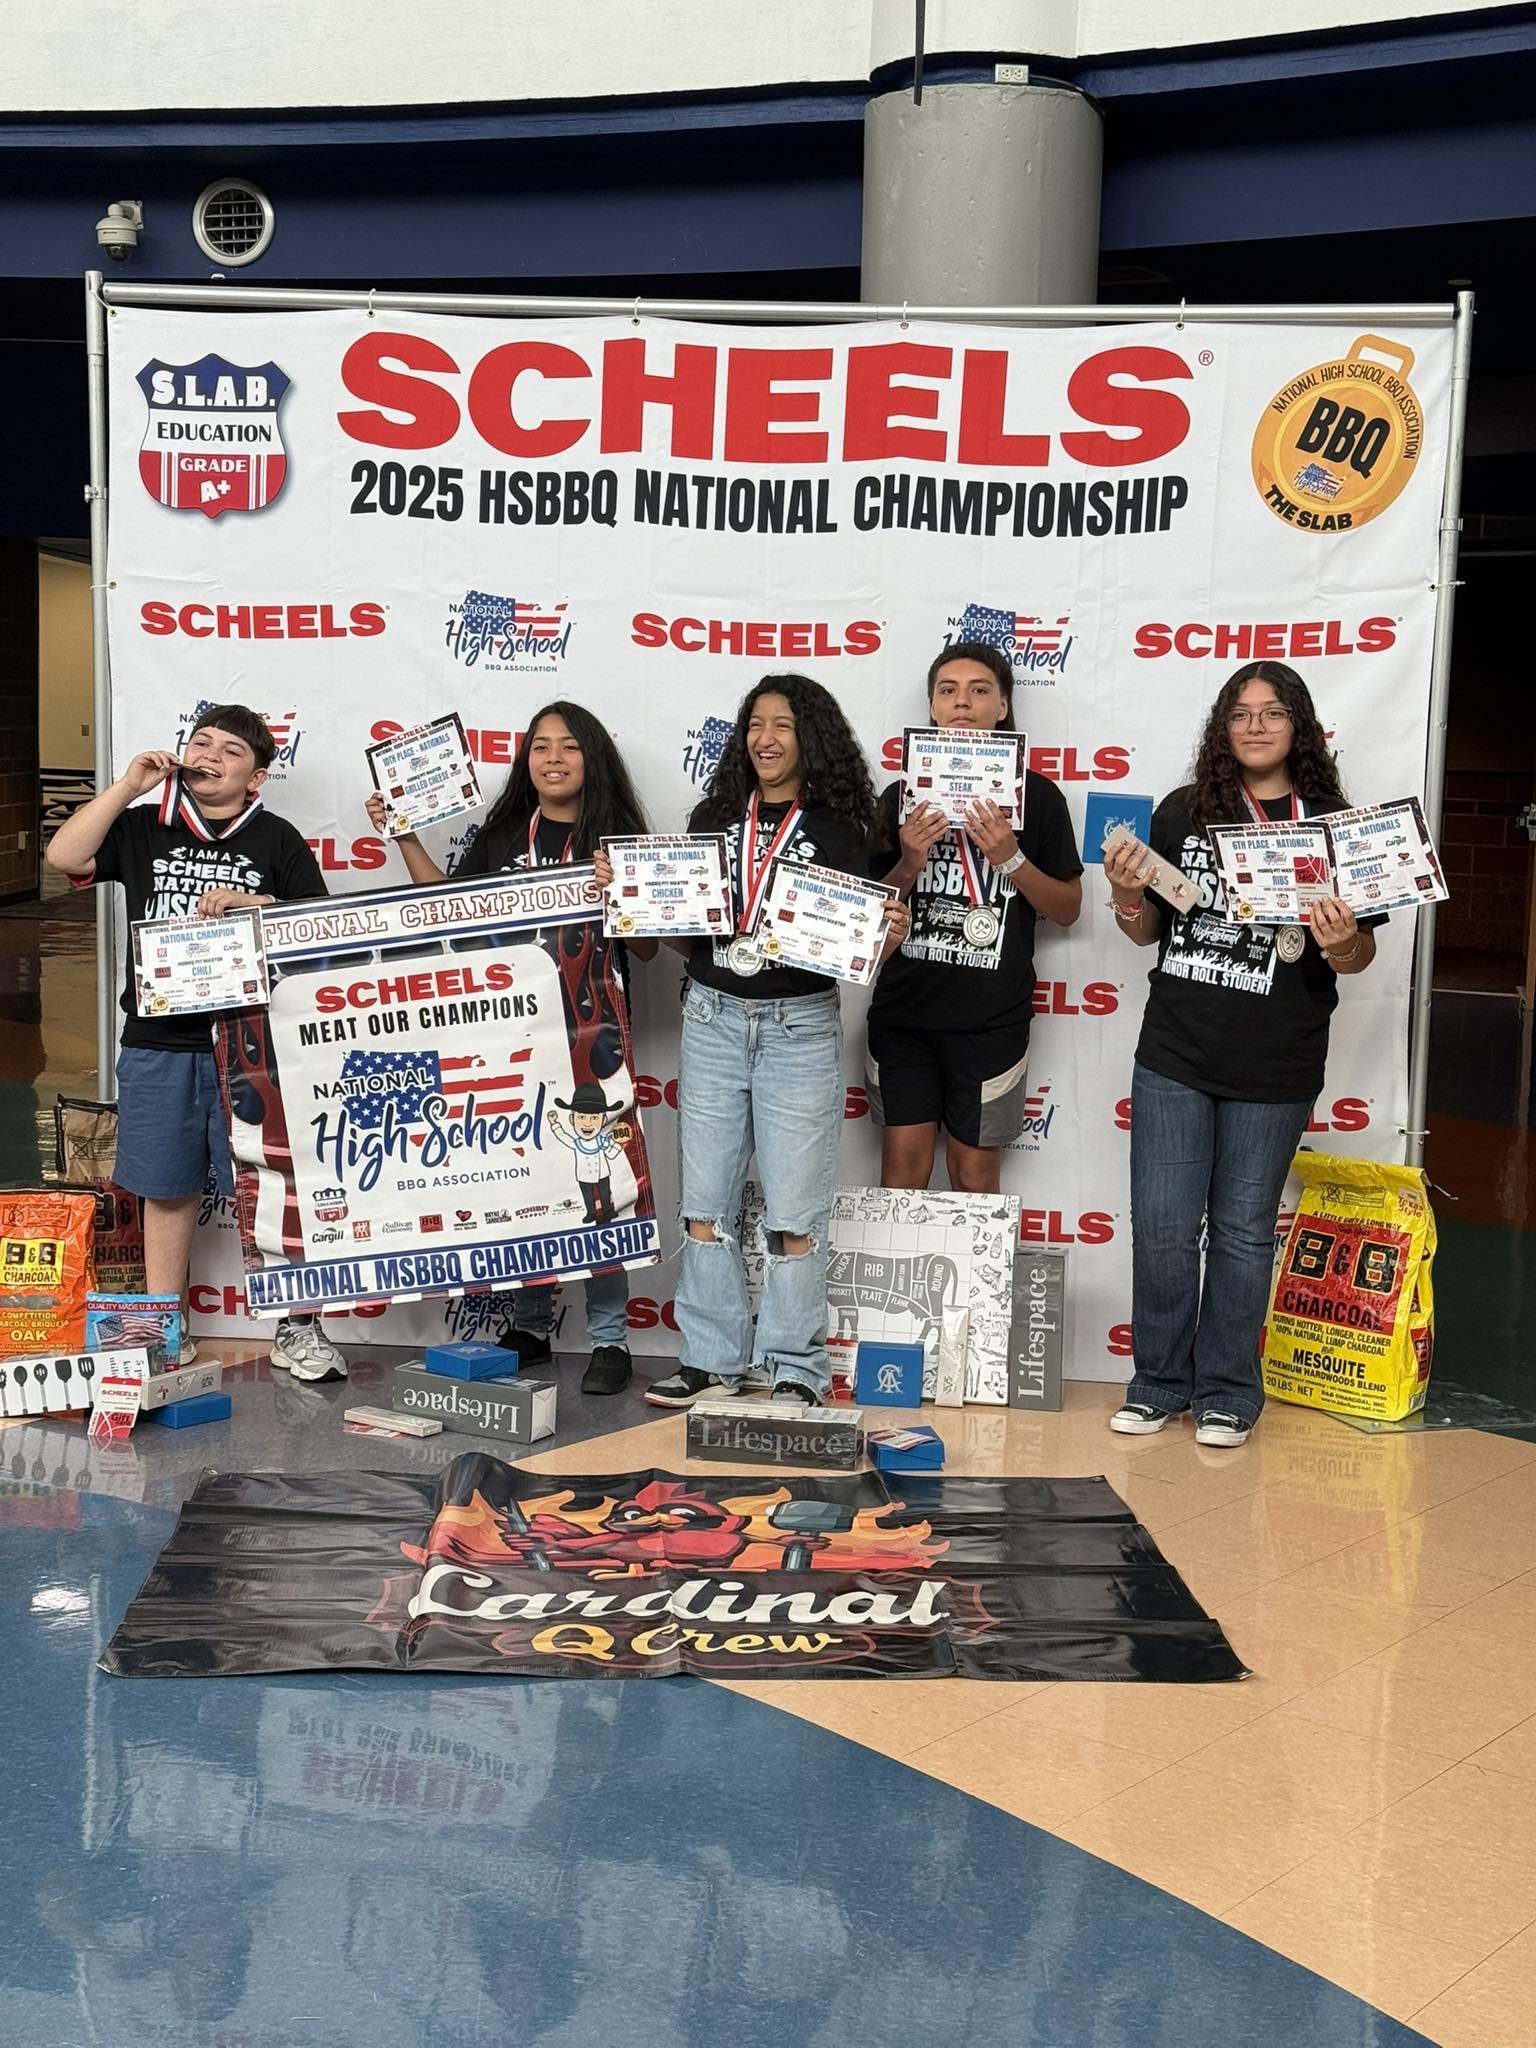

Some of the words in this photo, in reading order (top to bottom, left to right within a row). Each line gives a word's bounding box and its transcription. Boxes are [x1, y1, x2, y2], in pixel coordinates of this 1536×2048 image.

[151, 370, 275, 406] S.L.A.B.
[337, 332, 1194, 467] SCHEELS
[1272, 372, 1319, 413] NATIONAL
[1320, 364, 1345, 382] HIGH
[1347, 364, 1385, 385] SCHOOL
[1383, 375, 1404, 399] BBQ
[1397, 393, 1421, 459] ASSOCIATION
[157, 421, 272, 442] EDUCATION
[1295, 396, 1391, 480] BBQ
[179, 457, 248, 473] GRADE
[200, 479, 231, 503] A+
[350, 459, 463, 523] 2025
[478, 469, 618, 529] HSBBQ
[633, 469, 838, 535] NATIONAL
[852, 474, 1188, 537] CHAMPIONSHIP
[1264, 484, 1299, 521] THE
[1296, 513, 1353, 531] SLAB
[140, 601, 386, 640] SCHEELS
[449, 603, 511, 616] NATIONAL
[631, 611, 882, 658] SCHEELS
[947, 617, 1011, 630] NATIONAL
[445, 619, 493, 667] High
[499, 621, 572, 660] School
[1133, 616, 1396, 659] SCHEELS
[504, 664, 558, 673] ASSOCIATION
[391, 723, 432, 743] SCHEELS
[939, 729, 990, 738] SCHEELS
[396, 747, 416, 761] PLACE
[419, 733, 451, 750] NATIONALS
[916, 743, 943, 754] RESERVE
[944, 745, 974, 756] NATIONAL
[975, 747, 1010, 758] CHAMPION
[428, 770, 450, 786] CHEESE
[949, 781, 973, 793] STEAK
[1325, 804, 1379, 823] SCHEELS
[1242, 822, 1297, 831] SCHEELS
[1333, 828, 1353, 842] LACE
[1358, 818, 1402, 837] NATIONALS
[637, 835, 690, 843] SCHEELS
[1232, 840, 1247, 850] 6TH
[1248, 839, 1270, 849] PLACE
[1276, 838, 1315, 849] NATIONALS
[196, 849, 219, 861] AM
[221, 852, 231, 862] A
[623, 852, 638, 862] 4TH
[639, 852, 661, 862] PLACE
[668, 851, 706, 861] NATIONALS
[152, 858, 262, 887] SCHEELS
[808, 865, 862, 885] SCHEELS
[1272, 875, 1290, 886] RIBS
[1350, 863, 1385, 880] BRISKET
[652, 888, 684, 898] CHICKEN
[792, 878, 827, 896] NATIONAL
[828, 888, 867, 907] CHAMPION
[263, 908, 389, 947] TIONAL
[400, 879, 602, 928] CHAMPIONS
[160, 933, 194, 944] NATIONAL
[196, 928, 236, 940] CHAMPION
[192, 965, 212, 976] CHILI
[928, 949, 954, 965] ROLL
[955, 952, 1002, 971] STUDENT
[315, 962, 514, 1014] SCHEELS
[1191, 966, 1219, 985] ROLL
[1221, 971, 1274, 996] STUDENT
[298, 1016, 357, 1046] MEAT
[368, 1010, 410, 1038] OUR
[418, 993, 539, 1029] CHAMPIONS
[312, 1069, 434, 1101] NATIONAL
[310, 1102, 408, 1192] High
[421, 1082, 546, 1168] School
[613, 1127, 631, 1139] BBQ
[397, 1178, 428, 1191] BBQ
[432, 1166, 531, 1188] ASSOCIATION
[1366, 1219, 1386, 1228] LONG
[312, 1229, 344, 1243] Cargill
[248, 1262, 369, 1305] NATIONAL
[375, 1252, 464, 1291] MSBBQ
[470, 1221, 655, 1280] CHAMPIONSHIP
[831, 1254, 852, 1280] CHUCK
[864, 1263, 884, 1278] RIB
[4, 1271, 57, 1283] CHARCOAL
[931, 1263, 945, 1293] ROUND
[87, 1302, 117, 1311] QUALITY
[118, 1302, 139, 1310] MADE
[860, 1289, 883, 1303] PLATE
[891, 1296, 909, 1308] FLANK
[1, 1312, 57, 1320] COMPETITION
[445, 1299, 494, 1342] High
[1283, 1291, 1384, 1331] CHARCOAL
[10, 1329, 49, 1342] OAK
[1017, 1265, 1057, 1400] Lifespace
[1272, 1313, 1295, 1327] BURNS
[1296, 1319, 1323, 1333] HOTTER,
[1325, 1325, 1355, 1341] LONGER,
[1356, 1333, 1392, 1348] CLEANER
[1275, 1324, 1292, 1336] 100%
[1293, 1328, 1324, 1344] NATURAL
[1325, 1336, 1346, 1349] LUMP
[1346, 1341, 1386, 1356] CHARCOAL
[1292, 1347, 1366, 1379] MESQUITE
[1266, 1375, 1277, 1387] 20
[1297, 1384, 1314, 1398] NET
[1268, 1358, 1303, 1375] PREMIUM
[1303, 1368, 1356, 1388] HARDWOODS
[1357, 1380, 1387, 1393] BLEND
[101, 1389, 139, 1397] SCHEELS
[110, 1413, 130, 1422] Gift
[403, 1385, 520, 1435] Lifespace
[700, 1418, 845, 1463] Lifespace
[406, 1563, 950, 1627] Cardinal
[530, 1623, 617, 1661] Q
[616, 1623, 850, 1657] Crew
